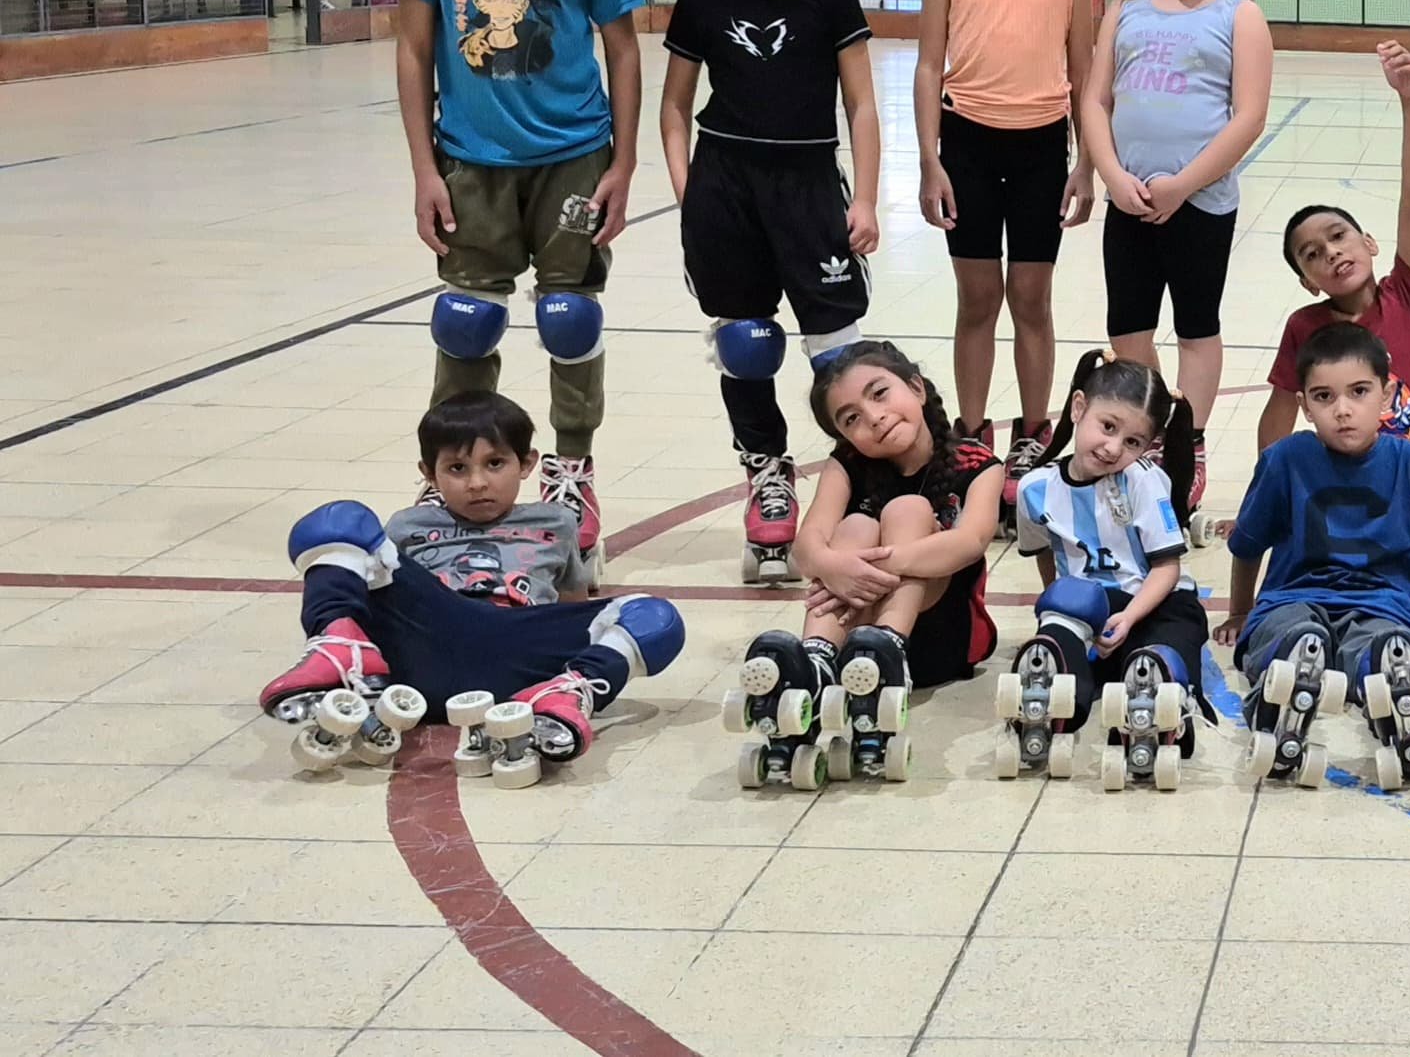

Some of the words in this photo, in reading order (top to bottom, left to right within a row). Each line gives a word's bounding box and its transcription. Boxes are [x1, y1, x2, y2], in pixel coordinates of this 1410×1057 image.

[1142, 41, 1176, 65] BE
[452, 303, 476, 314] MAC
[546, 302, 568, 313] MAC
[751, 327, 772, 338] MAC
